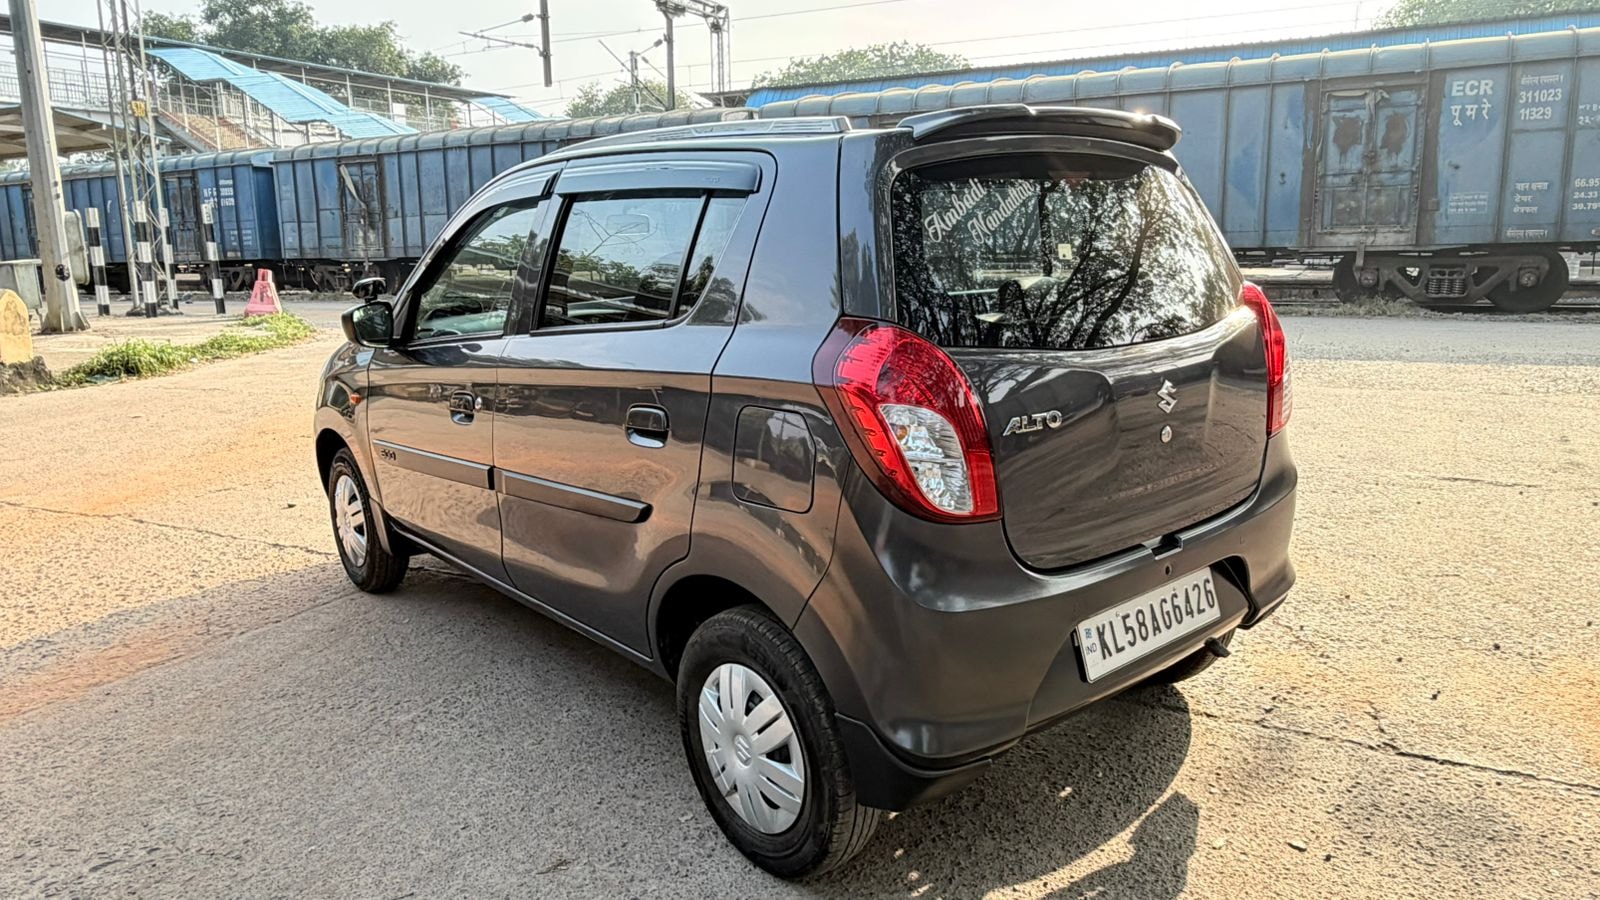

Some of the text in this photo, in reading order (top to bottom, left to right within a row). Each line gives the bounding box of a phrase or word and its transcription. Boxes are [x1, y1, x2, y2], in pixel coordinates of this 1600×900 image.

[1451, 80, 1493, 96] ECR
[1519, 88, 1562, 103] 311023
[1520, 106, 1552, 120] 11329
[924, 178, 987, 243] Ambadi
[1003, 410, 1063, 436] ALTO
[1096, 578, 1215, 660] KL58AG6426
